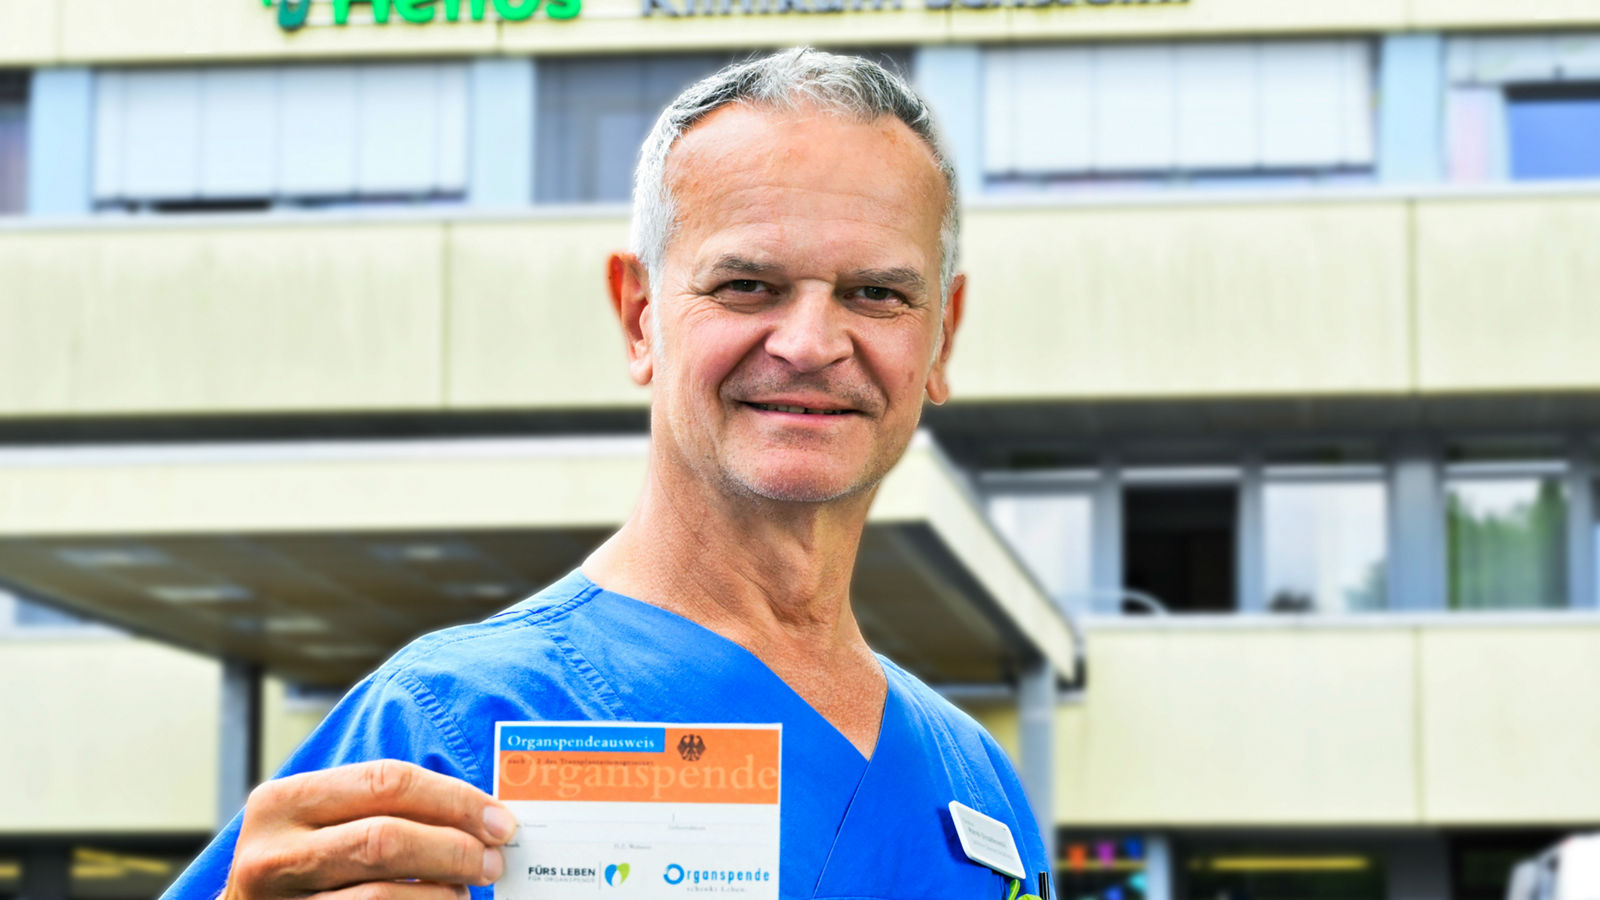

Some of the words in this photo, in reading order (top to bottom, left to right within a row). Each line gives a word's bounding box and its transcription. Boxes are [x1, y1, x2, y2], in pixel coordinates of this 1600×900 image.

[507, 735, 655, 751] Organspendeausweis
[500, 752, 778, 798] Organspende
[528, 864, 557, 876] FÜRS
[561, 867, 596, 877] LEBEN
[663, 863, 770, 885] Organspende
